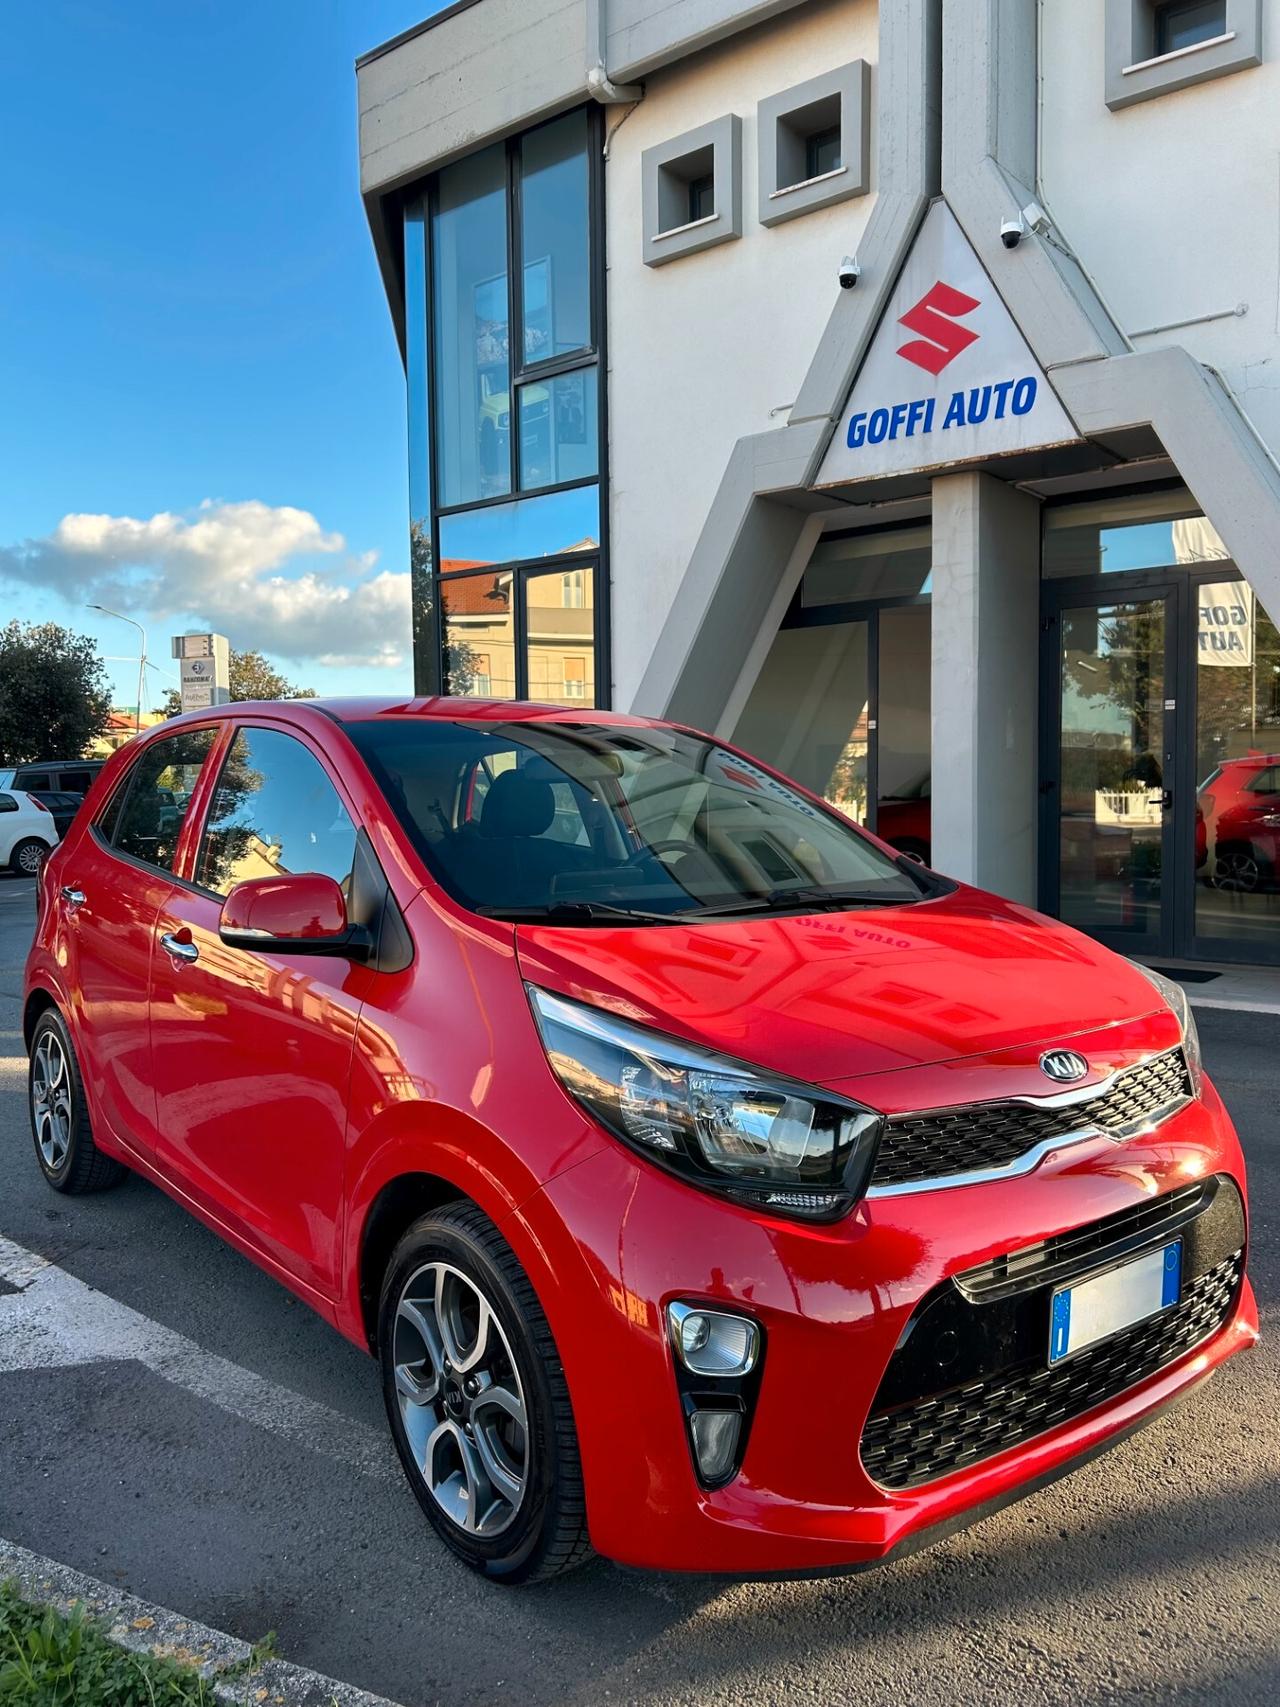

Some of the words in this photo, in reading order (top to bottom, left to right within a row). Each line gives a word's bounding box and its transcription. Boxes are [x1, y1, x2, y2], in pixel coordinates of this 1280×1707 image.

[847, 398, 936, 449] GOFFI
[942, 376, 1037, 429] AUTO
[1047, 1053, 1085, 1076] KIA
